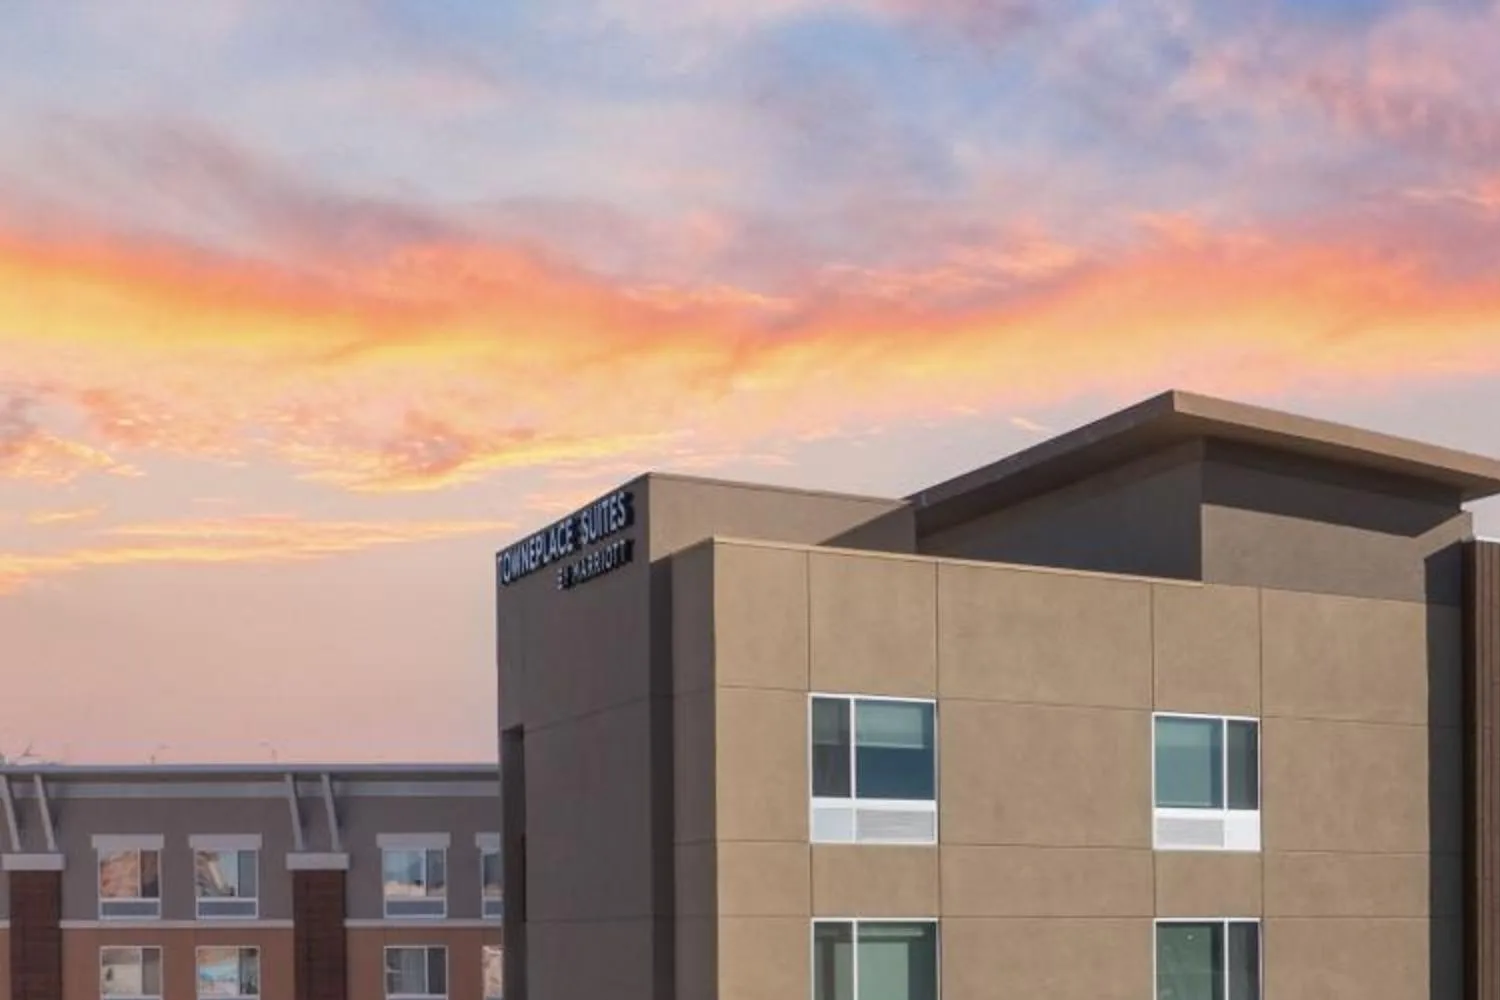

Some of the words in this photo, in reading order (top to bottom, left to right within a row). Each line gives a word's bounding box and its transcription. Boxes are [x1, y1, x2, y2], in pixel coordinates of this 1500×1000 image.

[498, 518, 574, 582] TOWNEPLACE
[581, 491, 626, 545] SUITES
[572, 539, 626, 581] MARRIOTT
